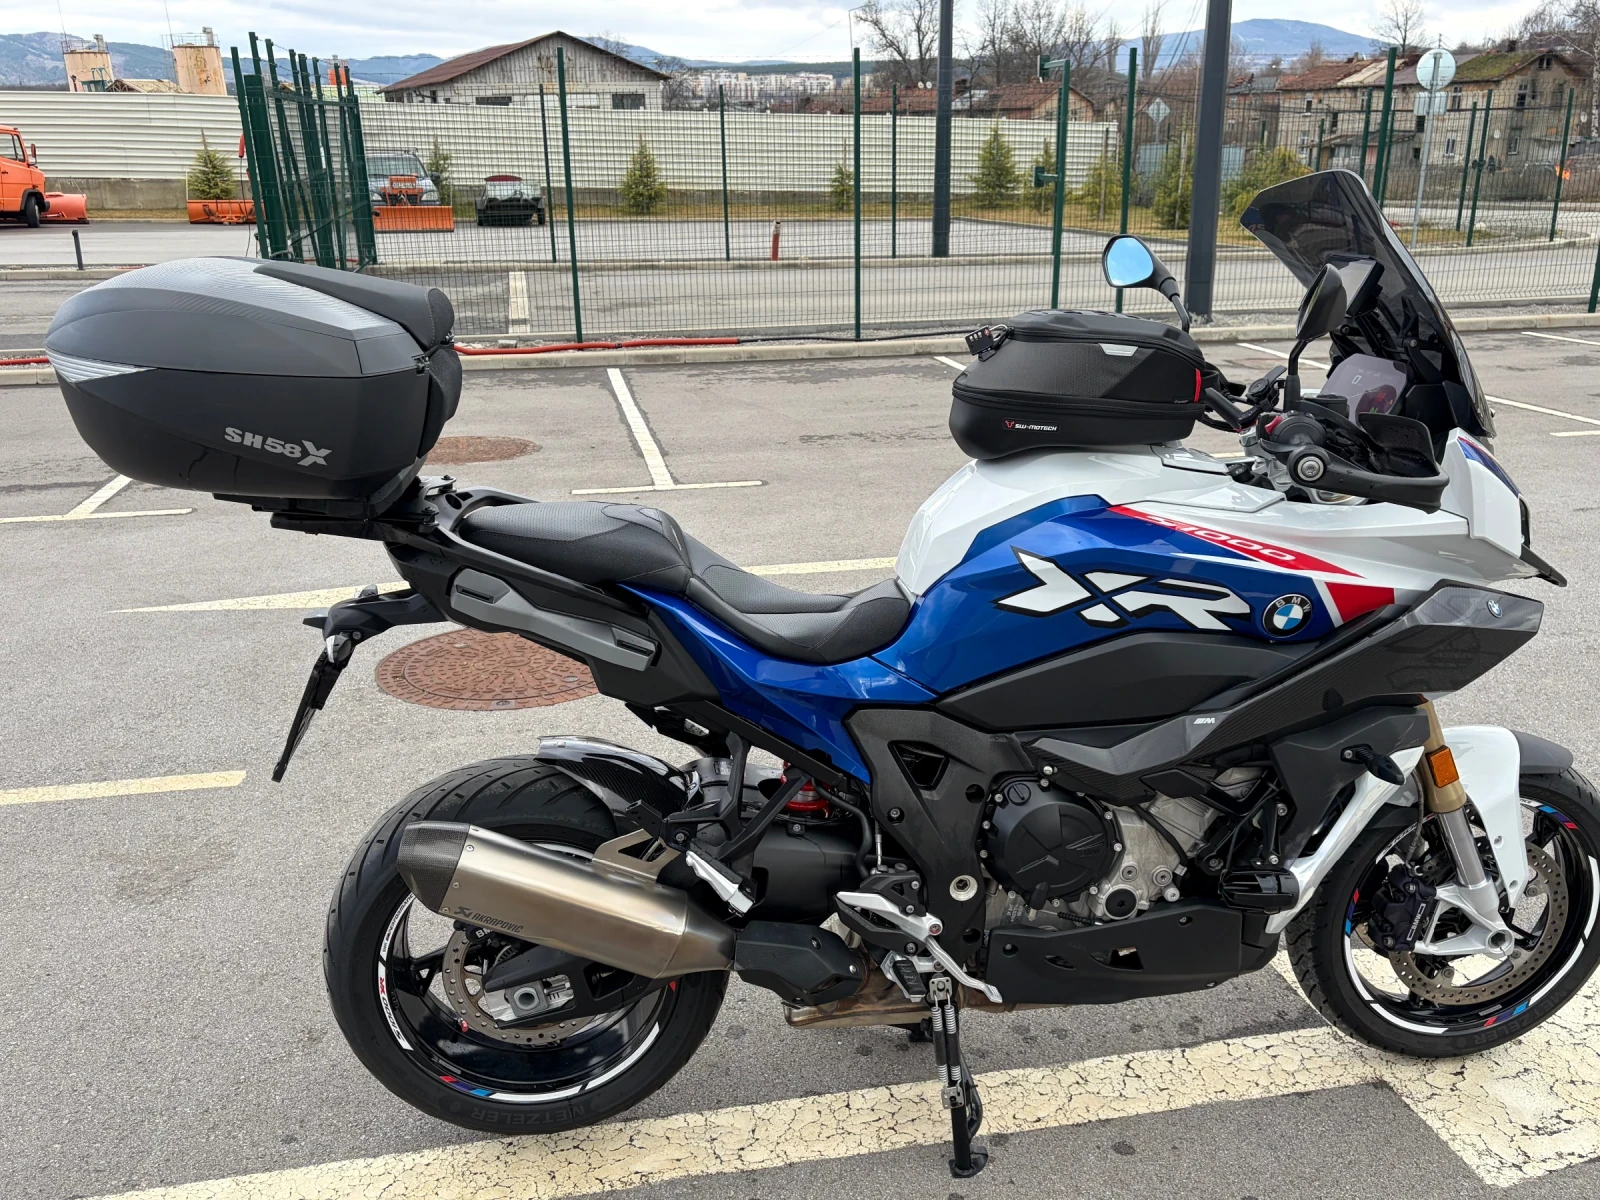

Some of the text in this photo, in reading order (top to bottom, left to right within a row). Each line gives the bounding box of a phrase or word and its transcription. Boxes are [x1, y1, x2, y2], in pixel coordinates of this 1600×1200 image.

[1014, 423, 1058, 432] SW-MOTECH
[224, 426, 333, 467] SH58X
[996, 545, 1252, 632] XR
[475, 926, 493, 938] BM
[470, 1106, 587, 1126] METZELER
